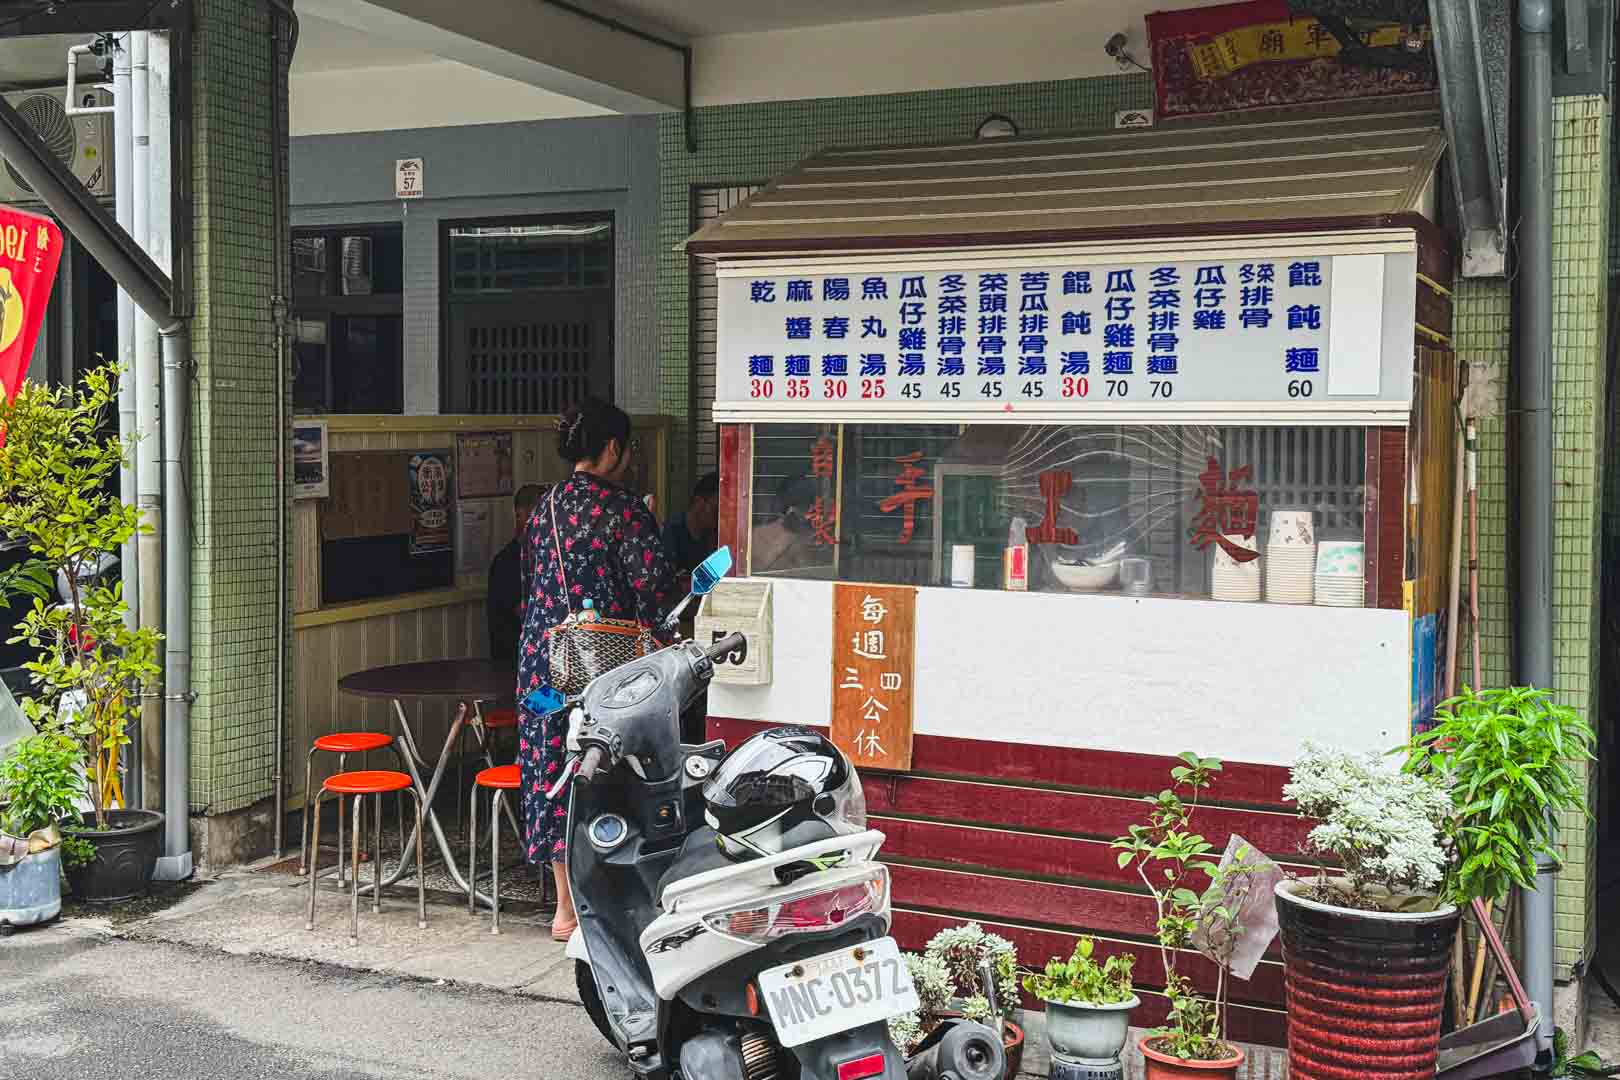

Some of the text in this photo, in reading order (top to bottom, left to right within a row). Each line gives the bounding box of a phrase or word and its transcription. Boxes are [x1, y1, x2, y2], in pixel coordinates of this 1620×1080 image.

[403, 177, 416, 190] 57
[749, 280, 775, 377] 乾麵
[785, 280, 813, 377] 麻醬麵
[822, 278, 849, 376] 陽春麵
[859, 277, 888, 376] 魚丸湯
[898, 275, 927, 376] 瓜仔雞湯
[937, 274, 967, 376] 冬菜排骨湯
[977, 273, 1008, 376] 菜頭排骨湯
[1018, 271, 1050, 375] 苦瓜排骨湯
[1060, 271, 1092, 375] 餛飩湯
[1103, 269, 1136, 375] 瓜仔雞麵
[1147, 266, 1181, 375] 冬菜排骨麵
[1193, 265, 1226, 330] 瓜仔雞
[1239, 263, 1275, 329] 冬菜排骨
[1285, 261, 1322, 373] 餛飩麵
[750, 377, 1313, 399] 30 35 30 25 45 45 45 45 30 70 70 60
